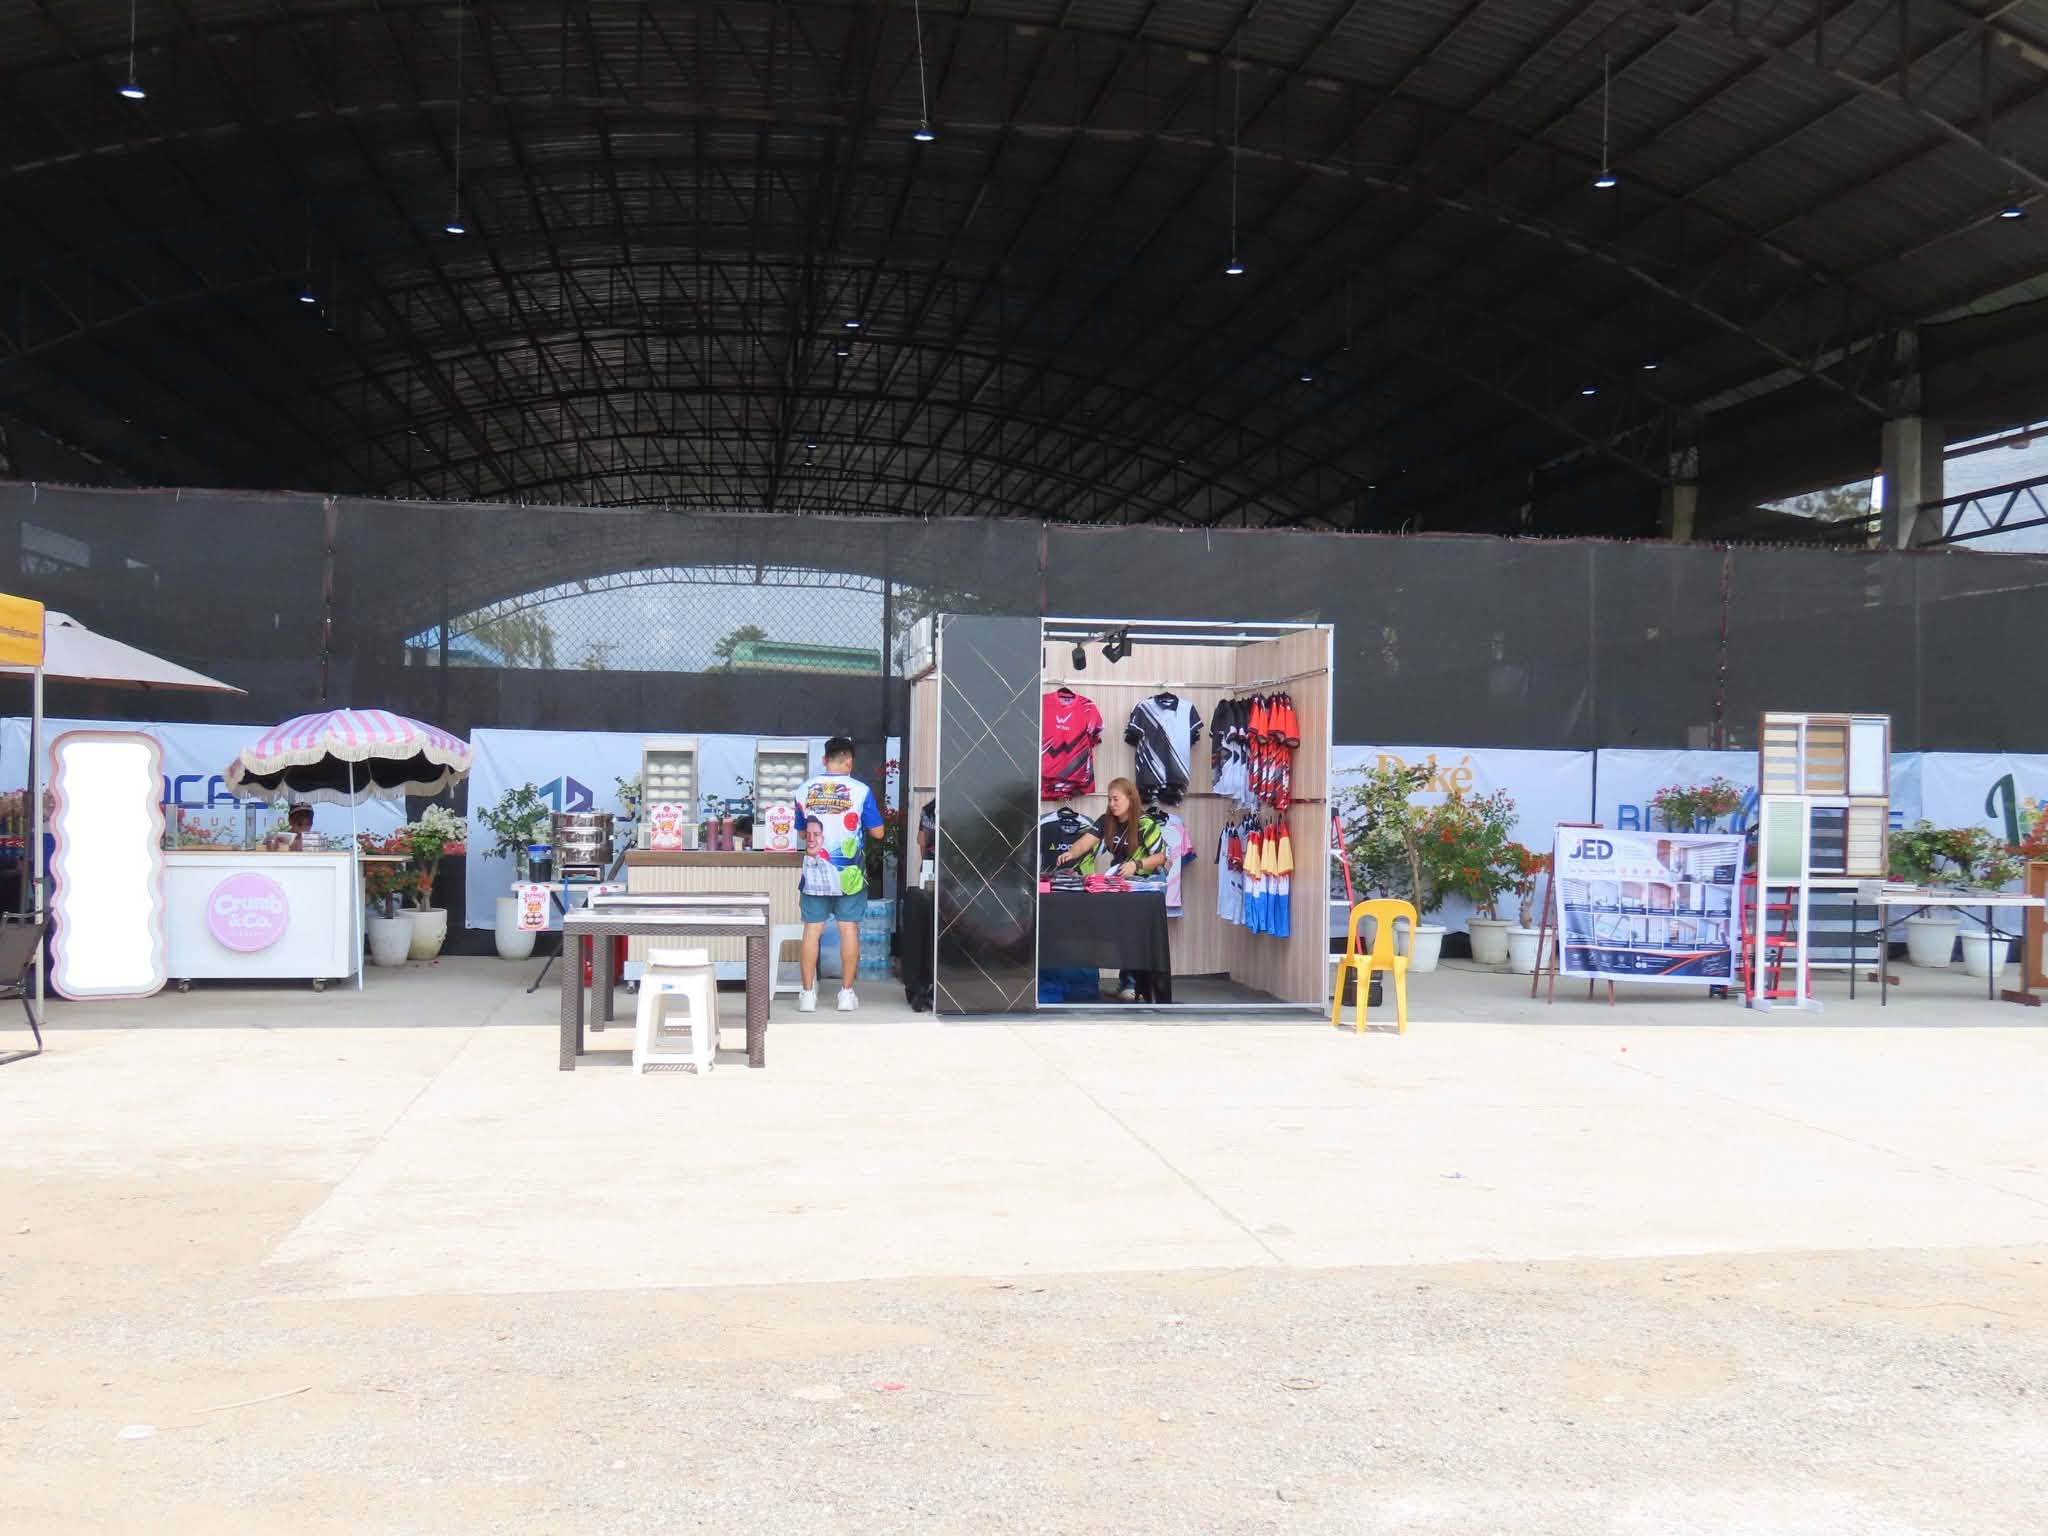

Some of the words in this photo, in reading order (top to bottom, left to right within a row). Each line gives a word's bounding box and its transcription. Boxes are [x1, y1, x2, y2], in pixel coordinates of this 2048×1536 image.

[1376, 753, 1473, 793] Dké
[1569, 839, 1613, 859] JED
[214, 894, 282, 914] Crumb
